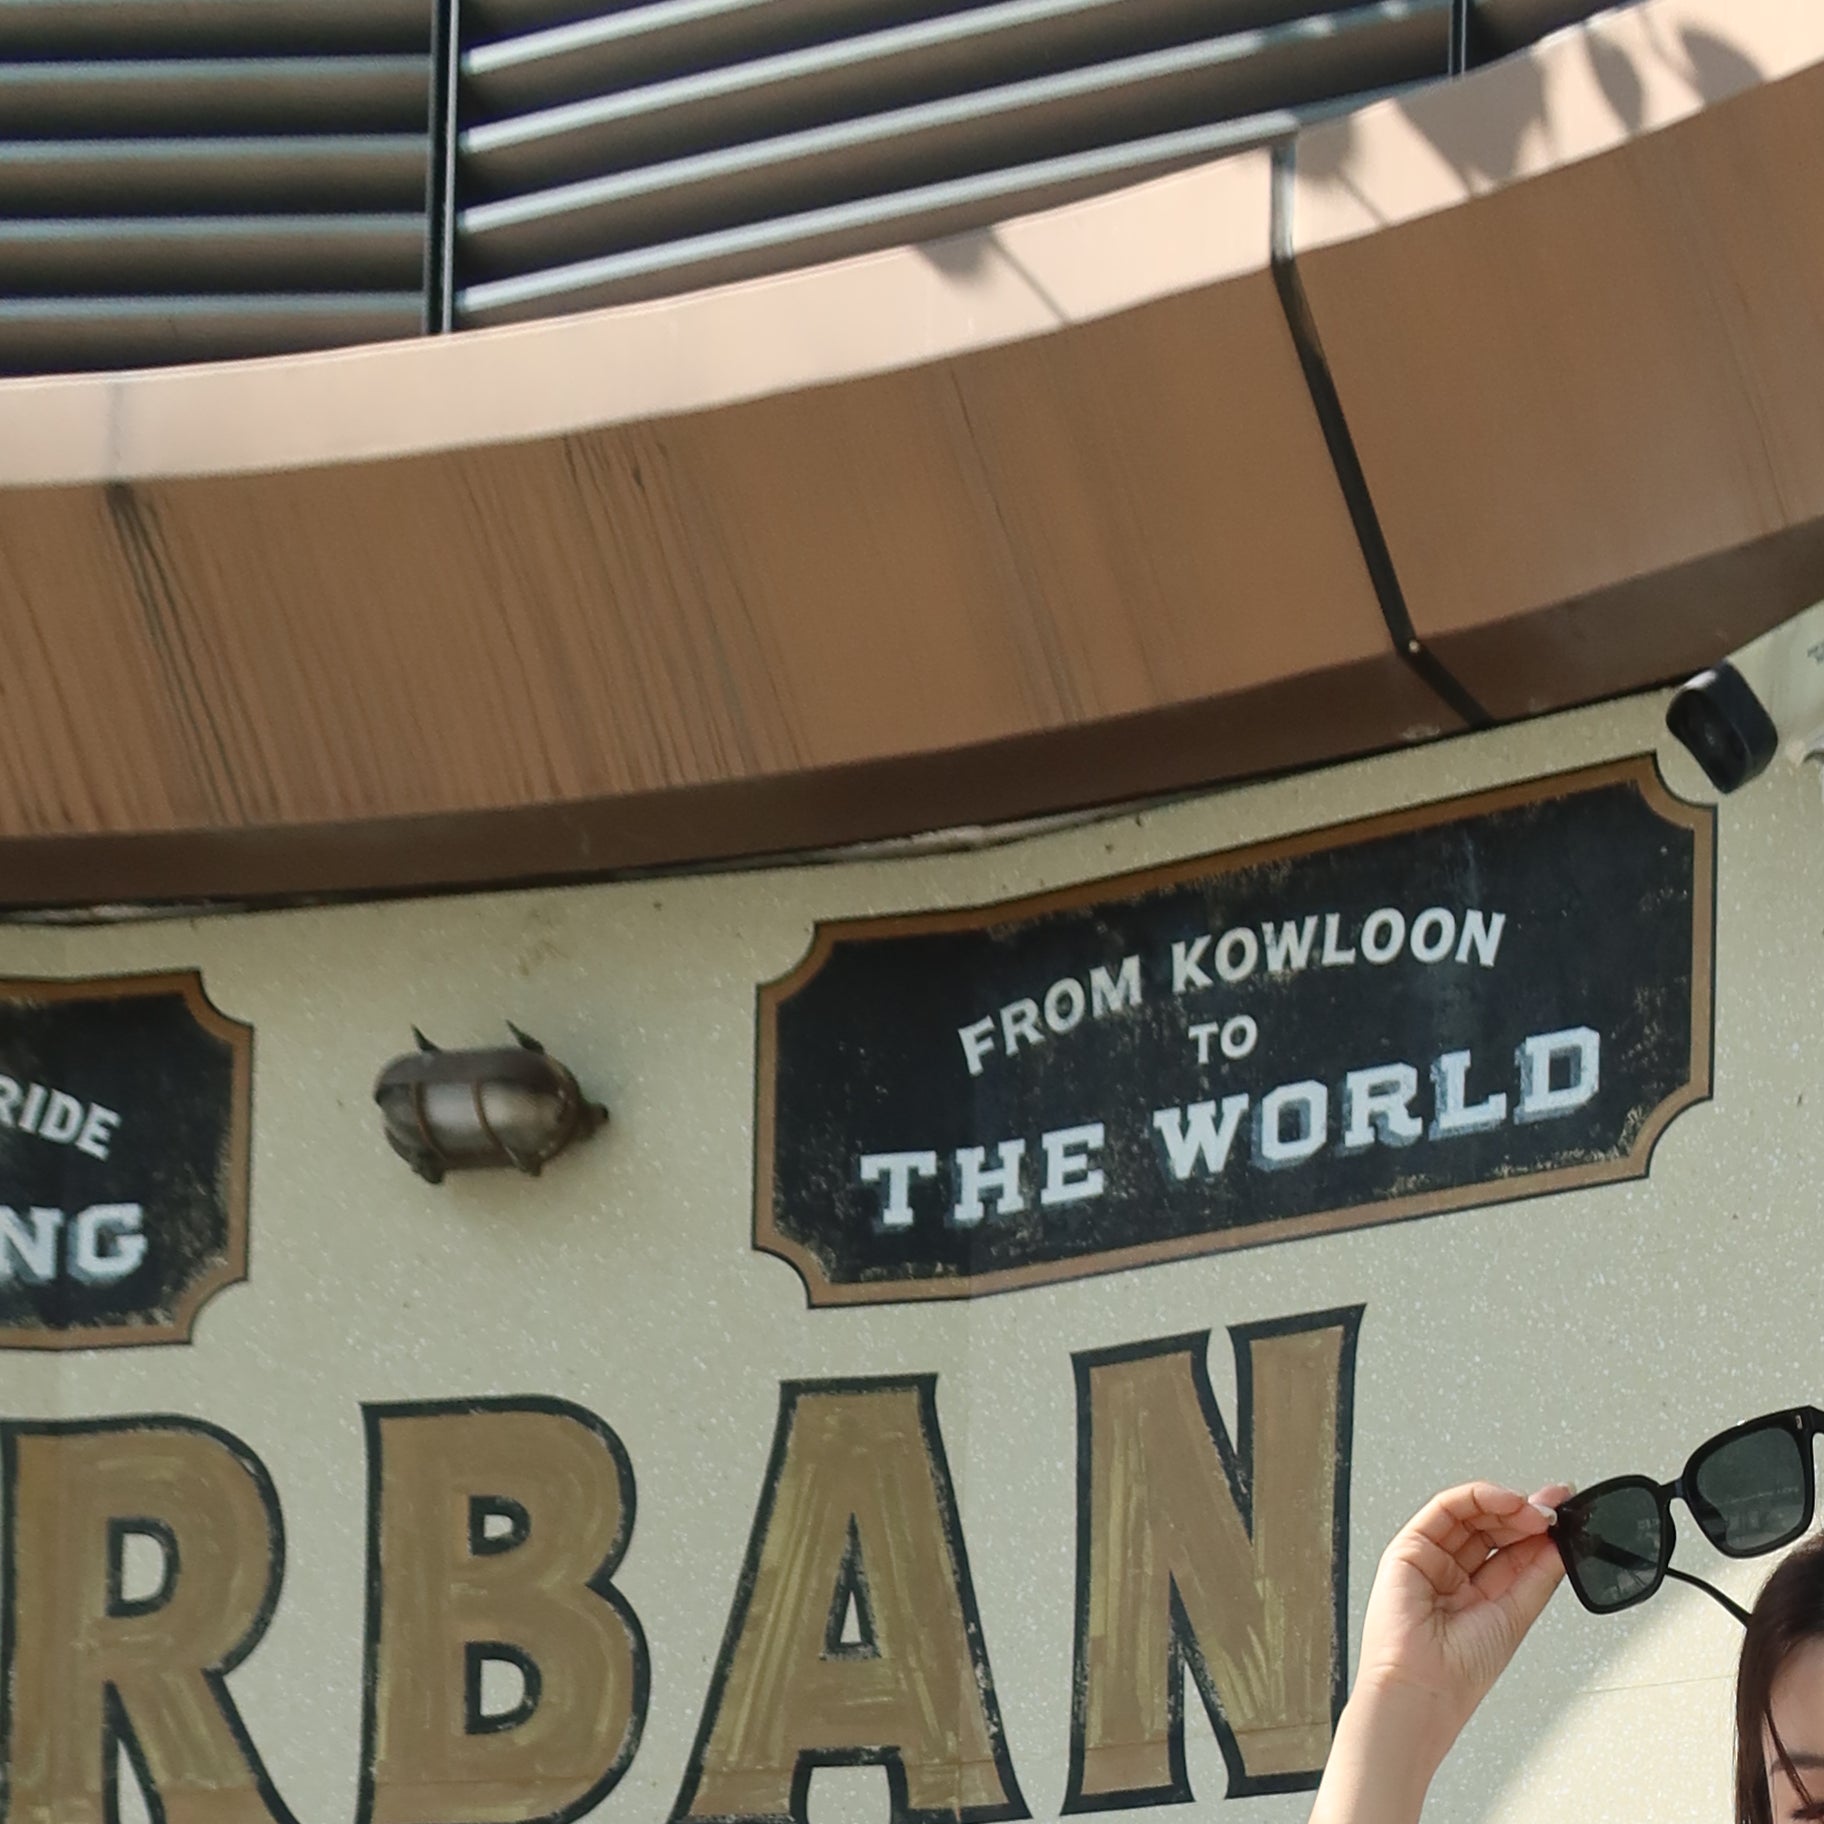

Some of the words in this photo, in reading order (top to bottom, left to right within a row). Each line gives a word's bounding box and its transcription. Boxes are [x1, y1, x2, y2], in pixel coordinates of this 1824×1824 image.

[957, 955, 1143, 1076] FROM
[1170, 907, 1506, 995] KOWLOON
[1189, 1014, 1258, 1065] TO
[858, 1120, 1108, 1232] THE
[1152, 1024, 1602, 1180] WORLD
